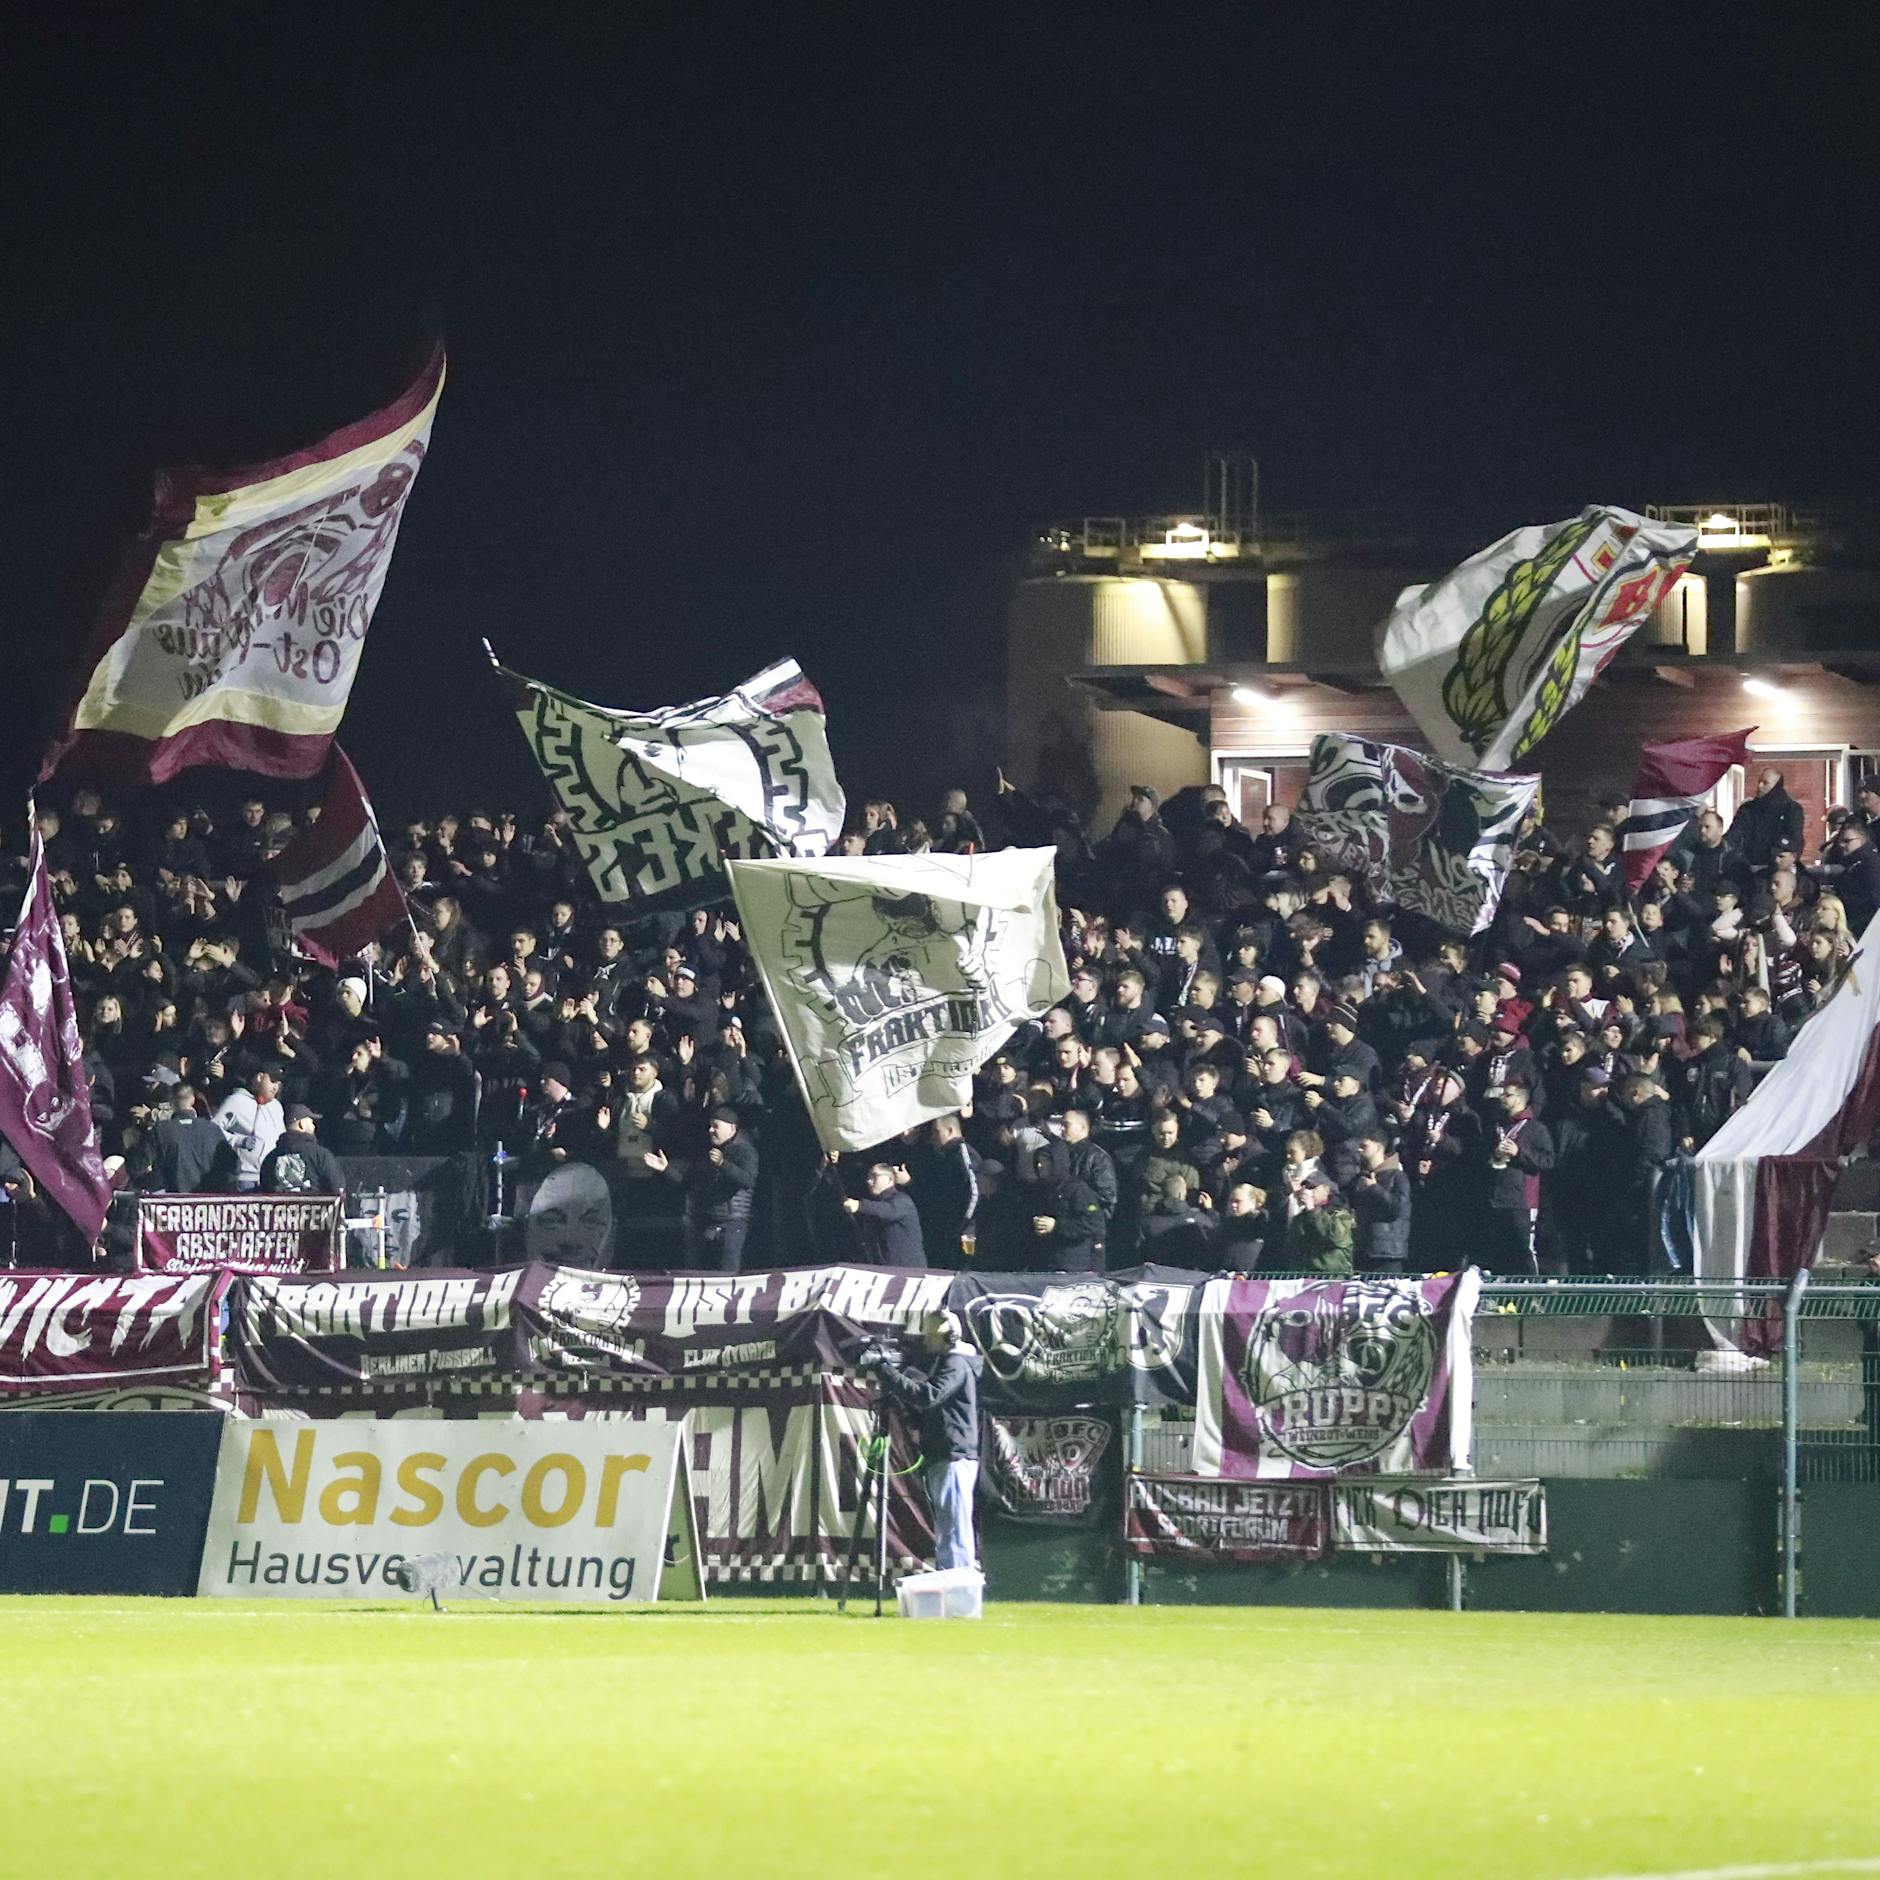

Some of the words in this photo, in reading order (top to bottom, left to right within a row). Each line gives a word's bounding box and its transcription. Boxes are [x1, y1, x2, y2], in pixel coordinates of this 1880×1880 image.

[176, 1231, 300, 1260] ABSCHAFFEN
[237, 1429, 651, 1529] Nascor
[227, 1541, 637, 1599] Hausvealtung
